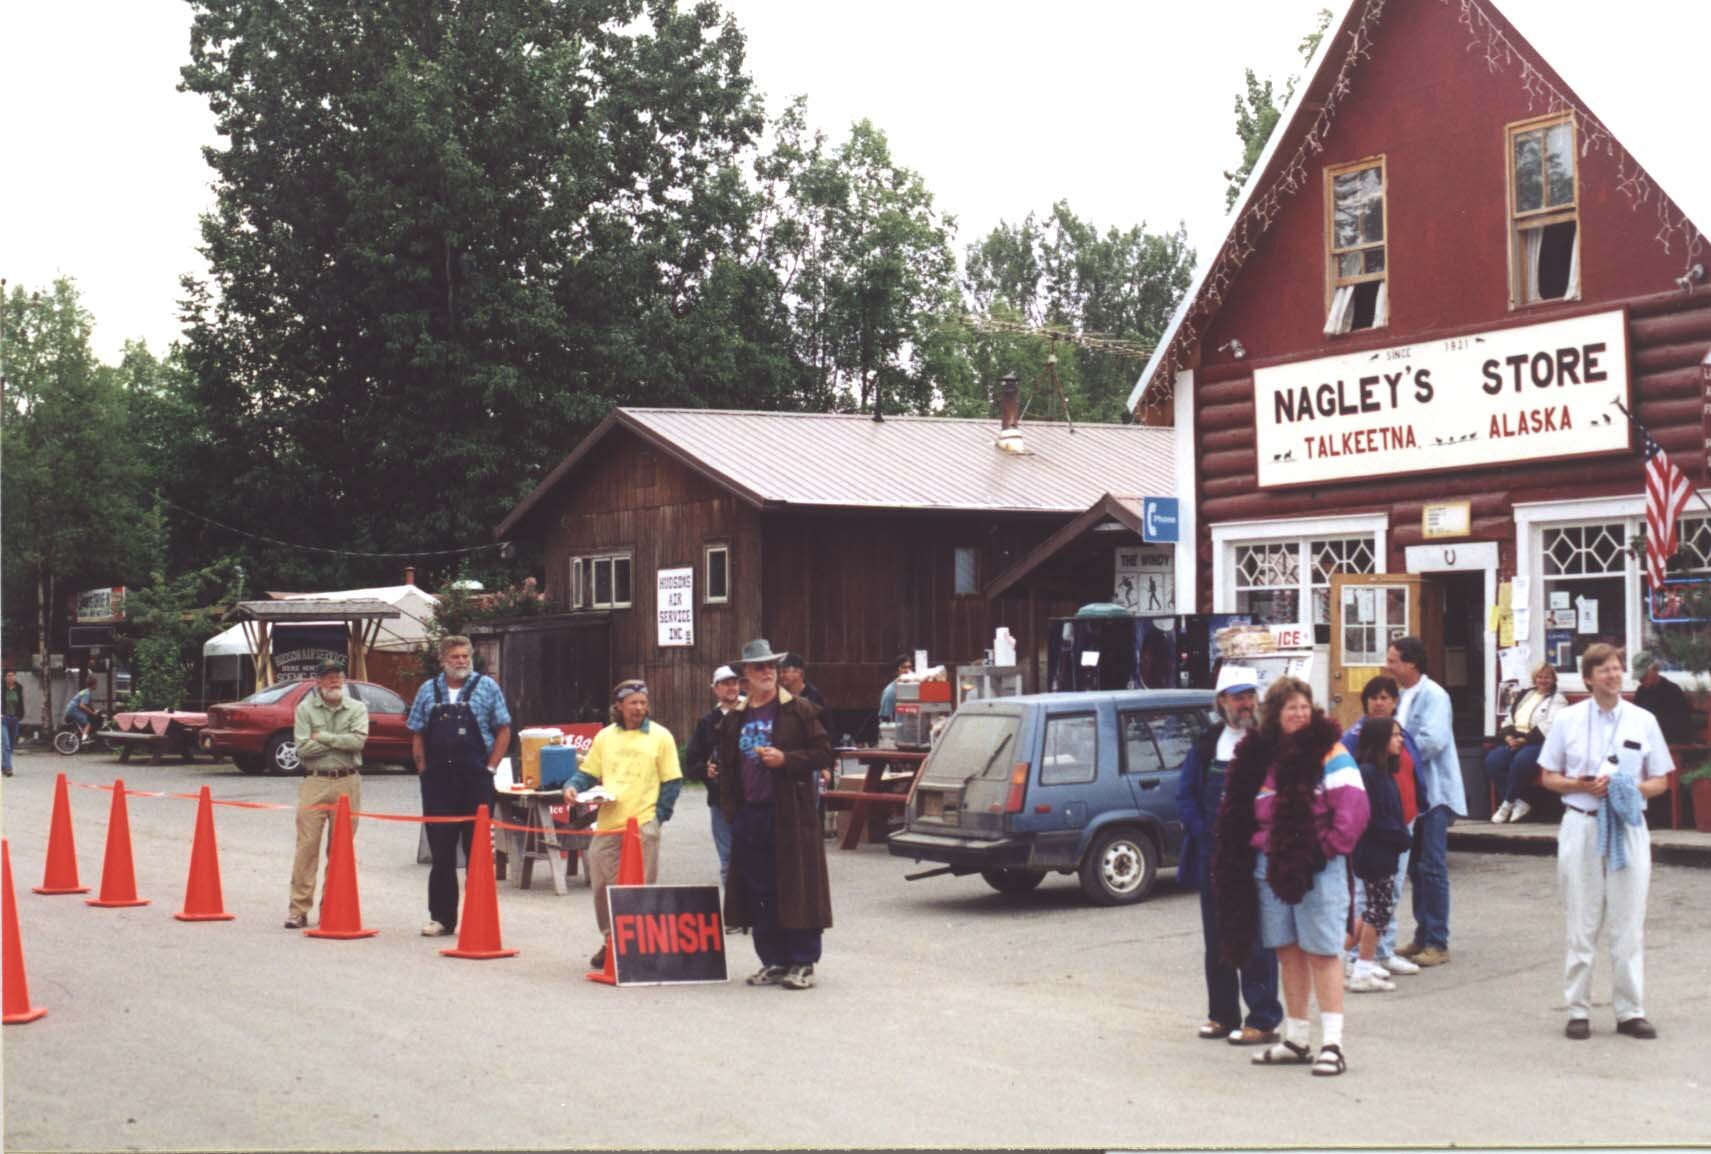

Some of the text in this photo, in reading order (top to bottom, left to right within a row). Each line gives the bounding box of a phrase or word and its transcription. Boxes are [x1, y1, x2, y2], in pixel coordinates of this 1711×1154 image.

[1386, 339, 1469, 361] SINCE 1921
[1273, 342, 1608, 425] NAGLEY'S STORE
[1488, 405, 1573, 439] ALASKA
[1120, 553, 1171, 568] THE WINDY
[659, 575, 691, 590] HUDSONS
[669, 592, 682, 607] AIR
[659, 609, 691, 623] SERVICE
[669, 627, 683, 641] INC
[1278, 630, 1301, 646] ICE
[614, 912, 722, 956] FINISH
